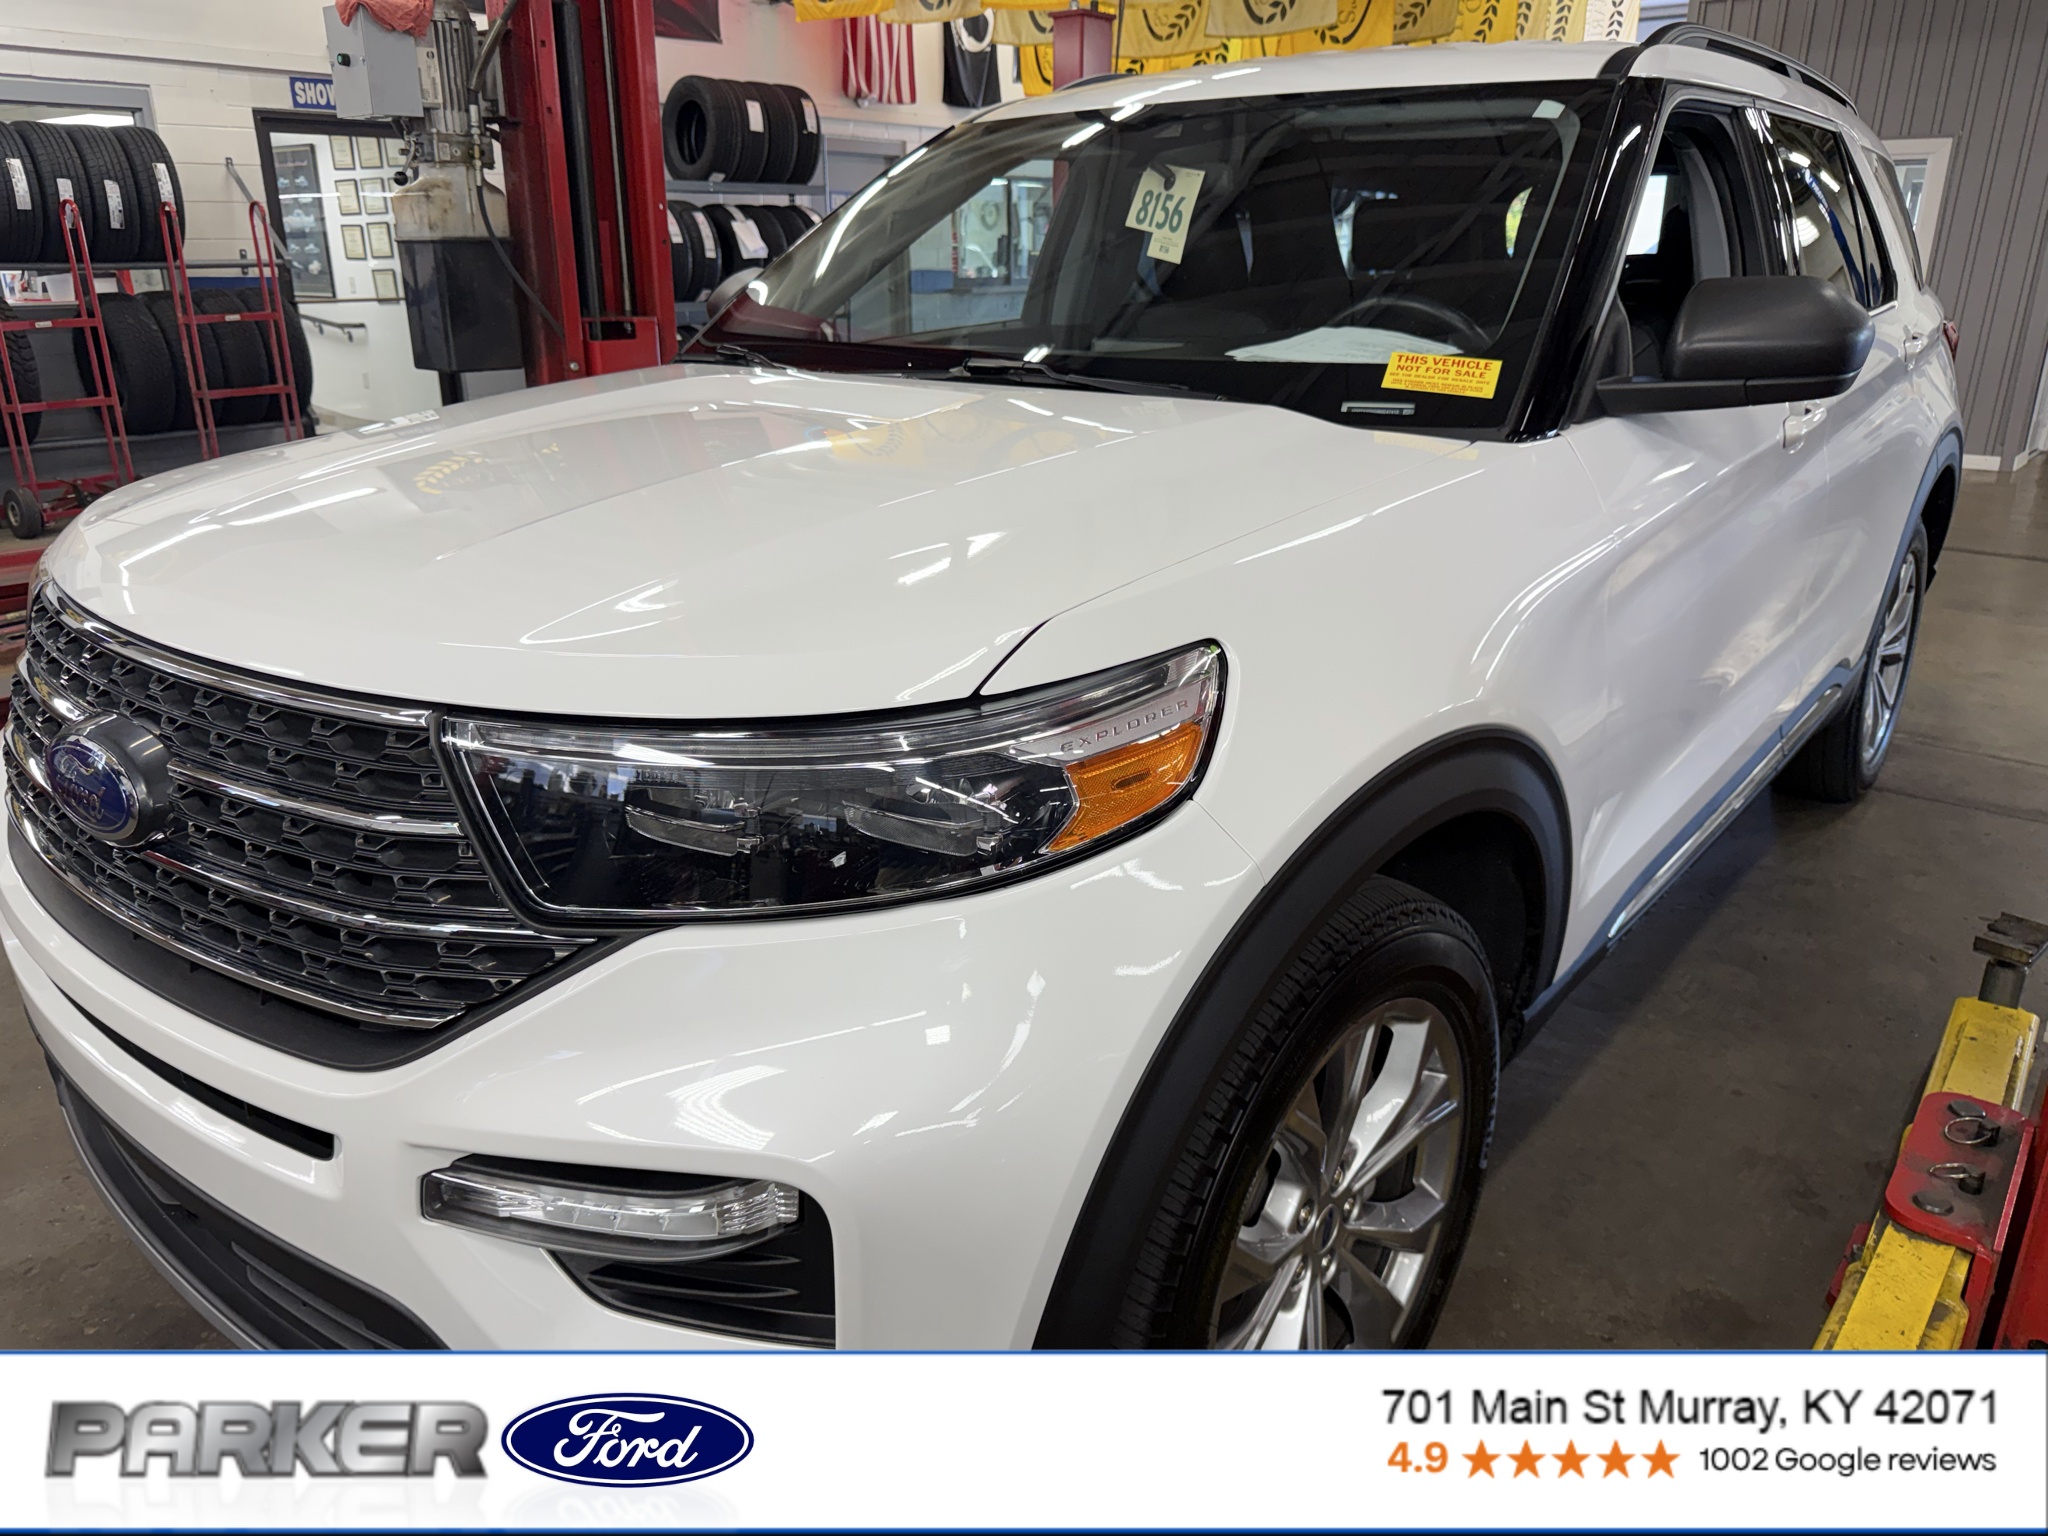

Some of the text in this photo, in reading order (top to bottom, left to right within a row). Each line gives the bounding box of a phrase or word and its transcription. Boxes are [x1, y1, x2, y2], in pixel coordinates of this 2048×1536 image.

[1135, 190, 1186, 234] 8156
[1396, 365, 1487, 379] NOT FOR SALE
[1397, 354, 1493, 371] THIS VEHICLE
[1060, 700, 1189, 753] EXPLORER
